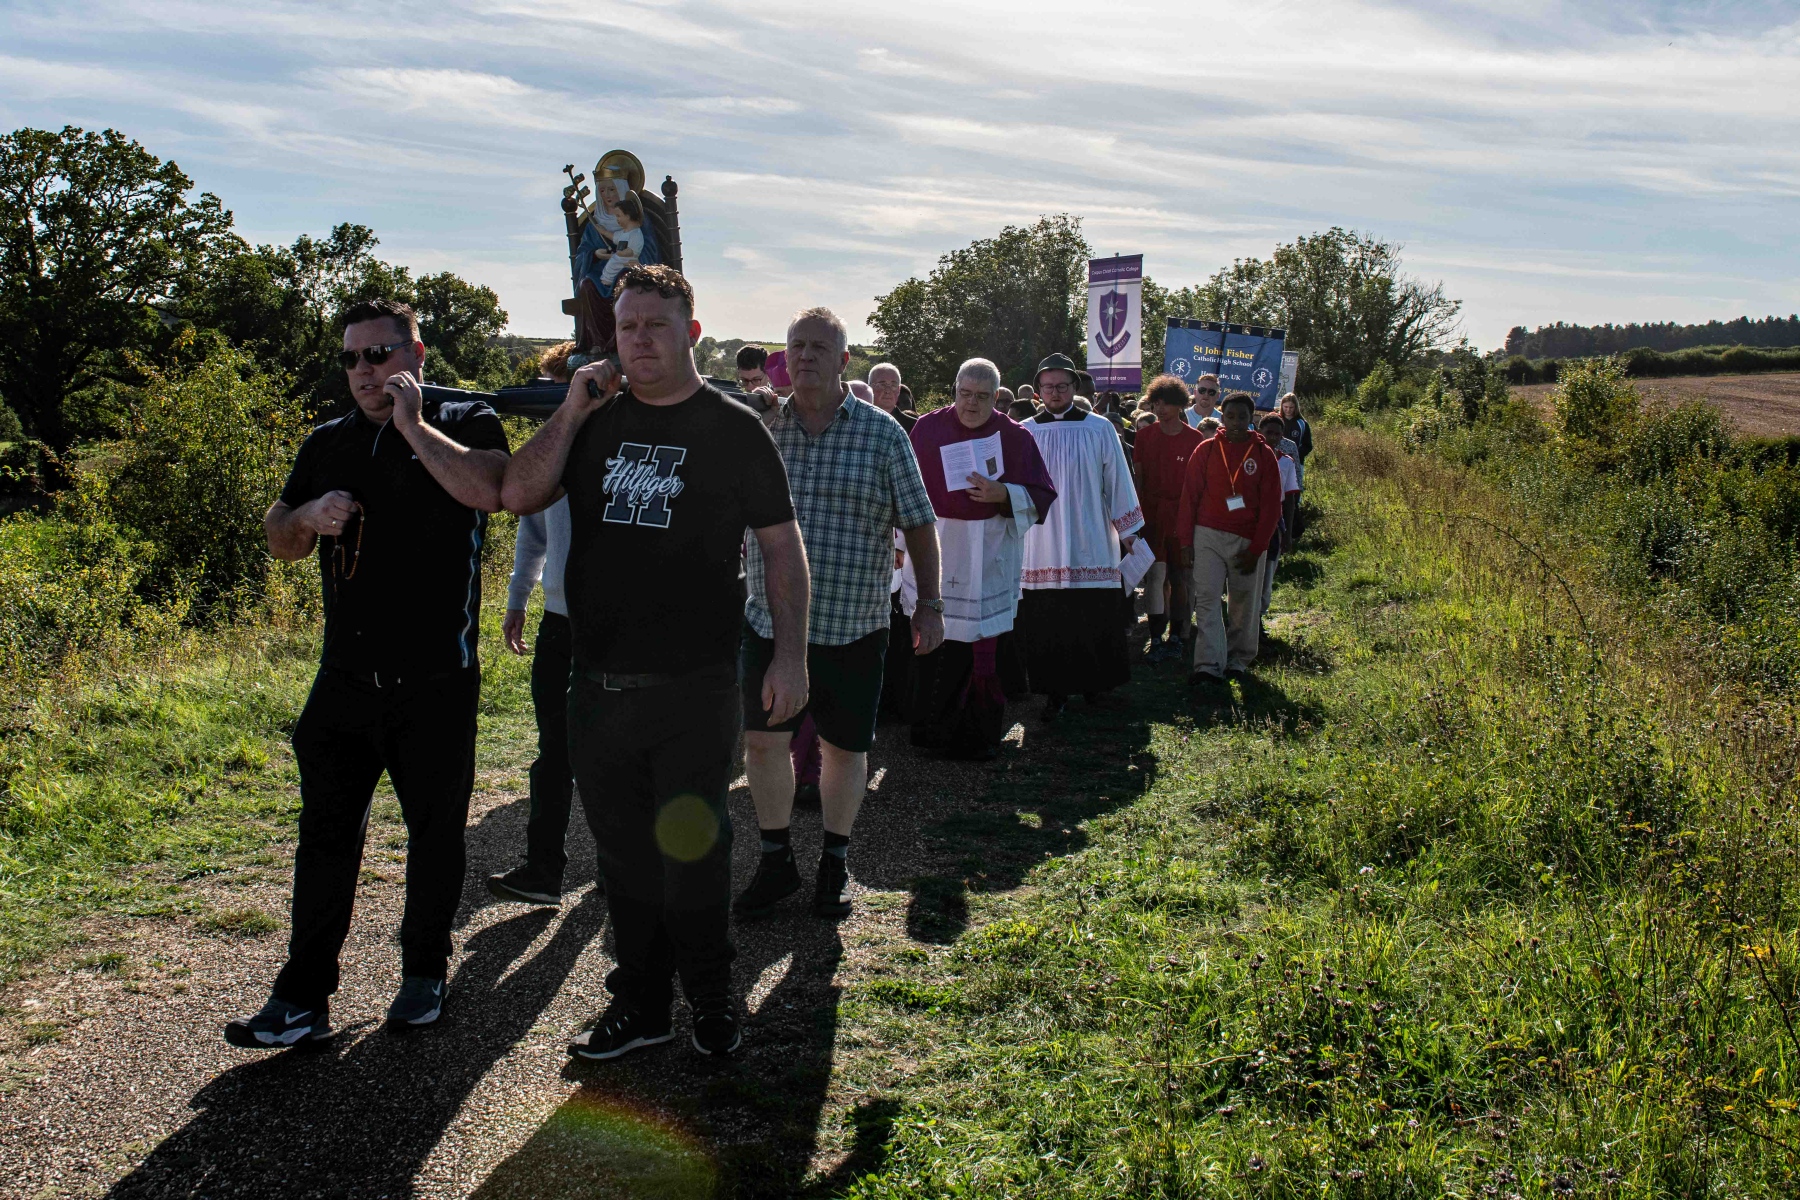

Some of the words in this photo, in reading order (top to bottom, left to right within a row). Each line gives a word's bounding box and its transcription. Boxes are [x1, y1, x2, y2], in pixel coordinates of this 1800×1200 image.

[1193, 345, 1203, 354] St
[1204, 346, 1223, 356] John
[1226, 348, 1255, 360] Fisher
[1193, 355, 1217, 363] Catholic
[602, 457, 684, 505] Hilfiger
